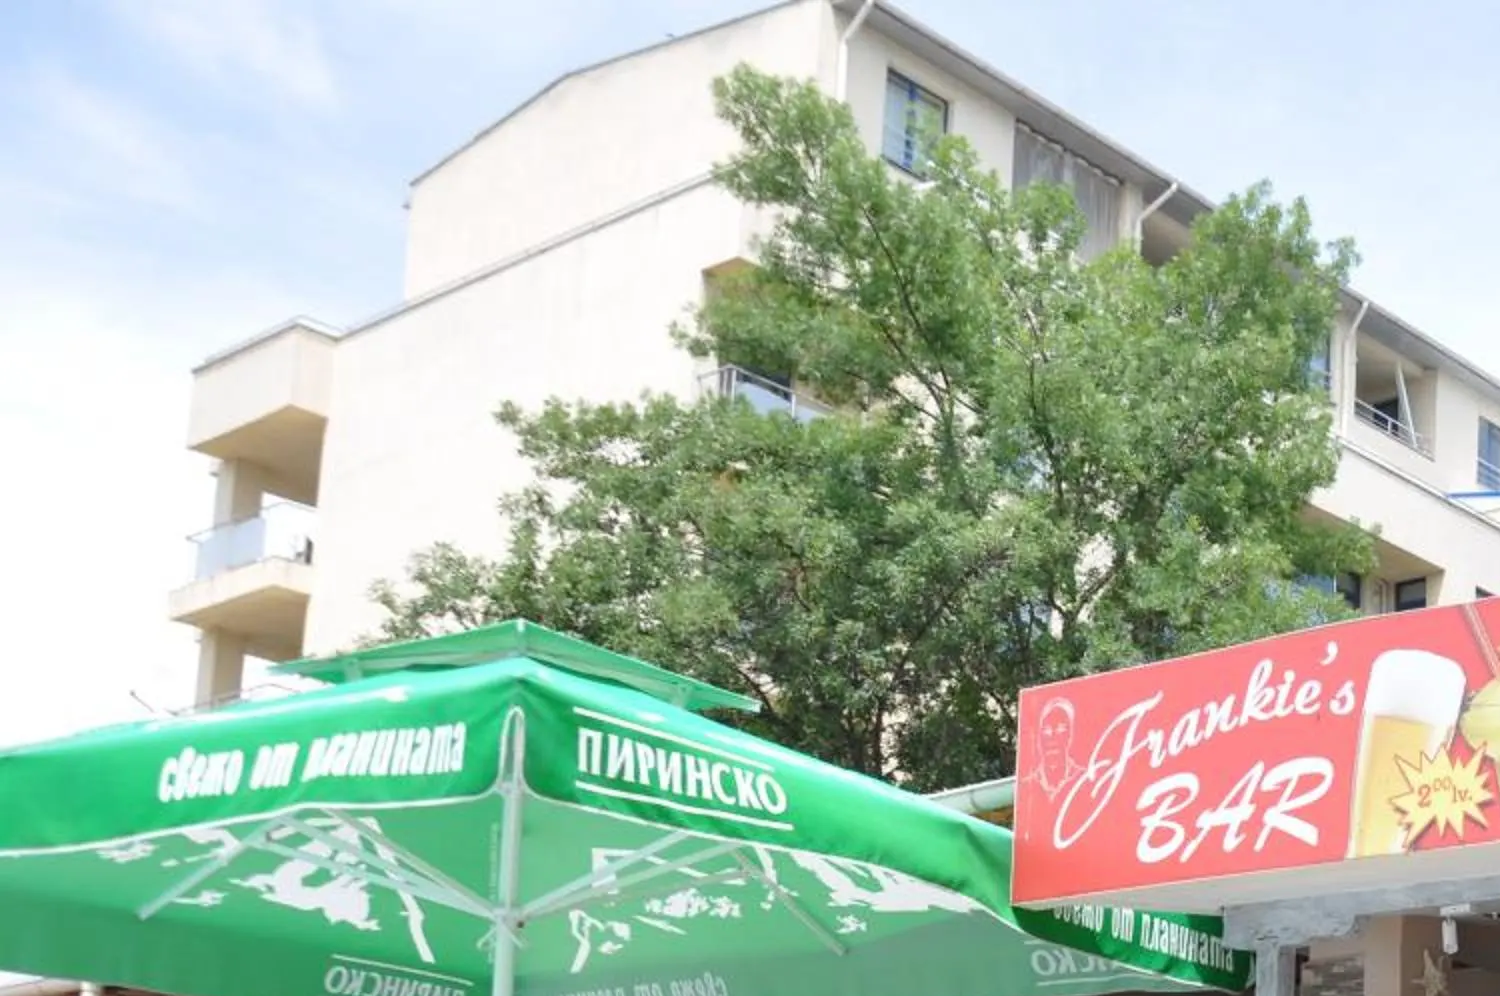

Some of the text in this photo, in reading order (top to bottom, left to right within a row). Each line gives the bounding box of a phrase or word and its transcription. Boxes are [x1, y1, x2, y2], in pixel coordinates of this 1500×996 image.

[577, 727, 787, 815] ПИРИНСКО
[1053, 640, 1356, 850] Frankie's
[1135, 756, 1335, 864] BAR
